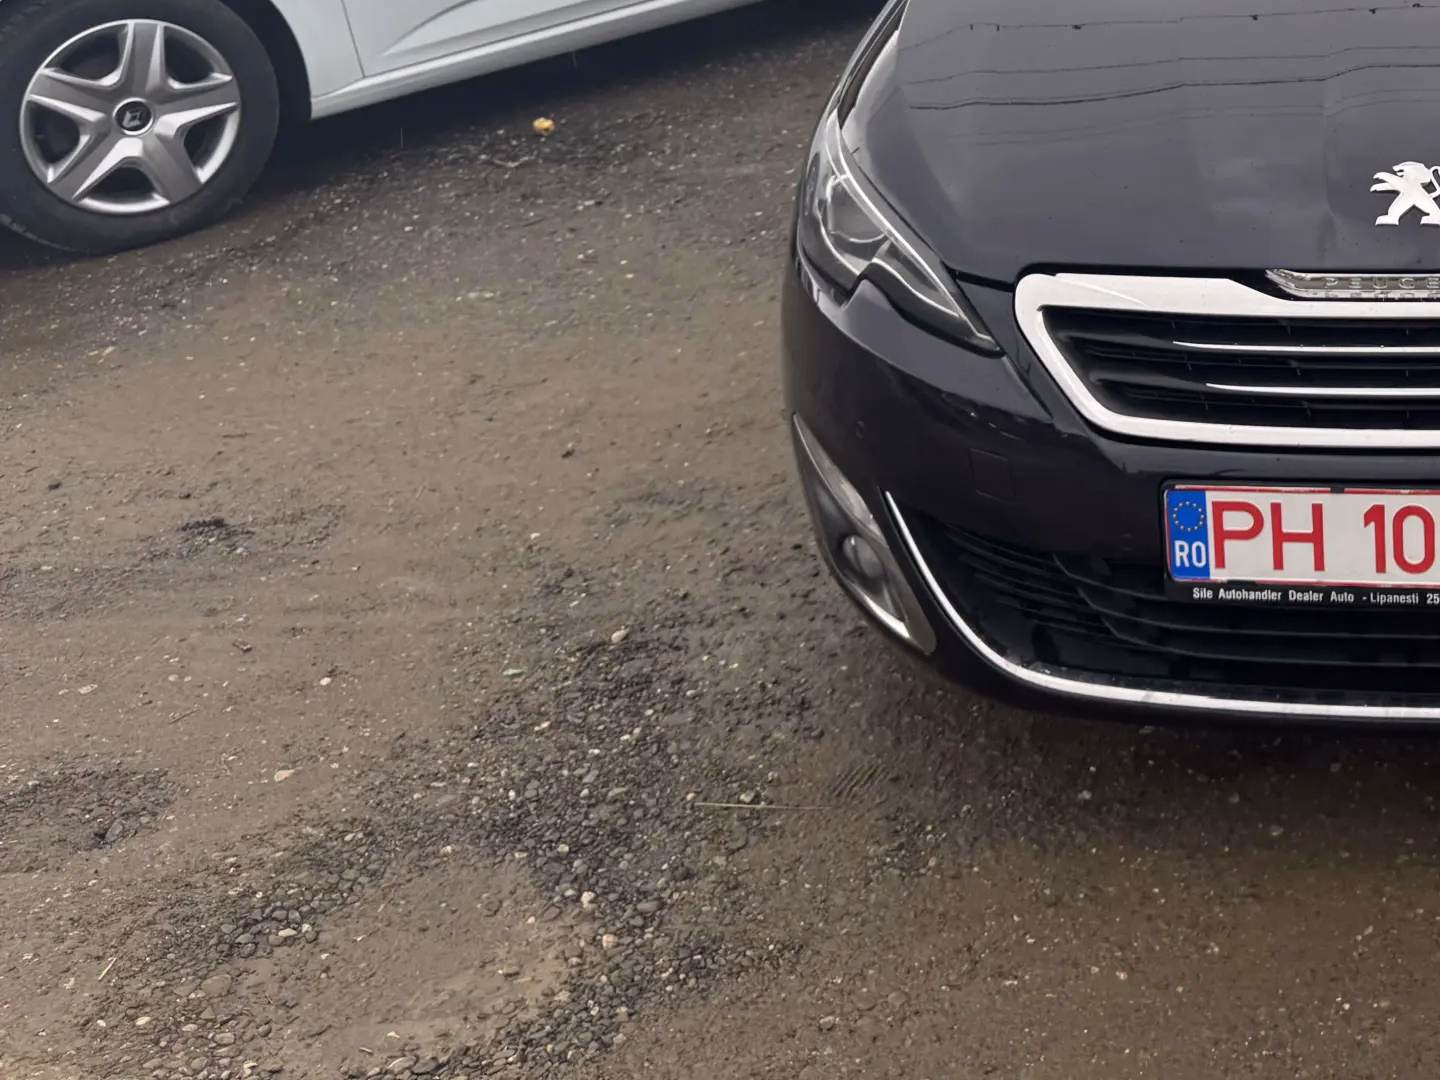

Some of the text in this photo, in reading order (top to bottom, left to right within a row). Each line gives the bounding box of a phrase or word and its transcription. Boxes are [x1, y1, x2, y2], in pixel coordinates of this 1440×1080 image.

[1211, 500, 1326, 572] PH
[1175, 540, 1206, 568] RO
[1192, 587, 1213, 600] Sile
[1218, 588, 1282, 602] Autohandler
[1288, 589, 1324, 602] Dealer
[1330, 591, 1355, 603] Auto
